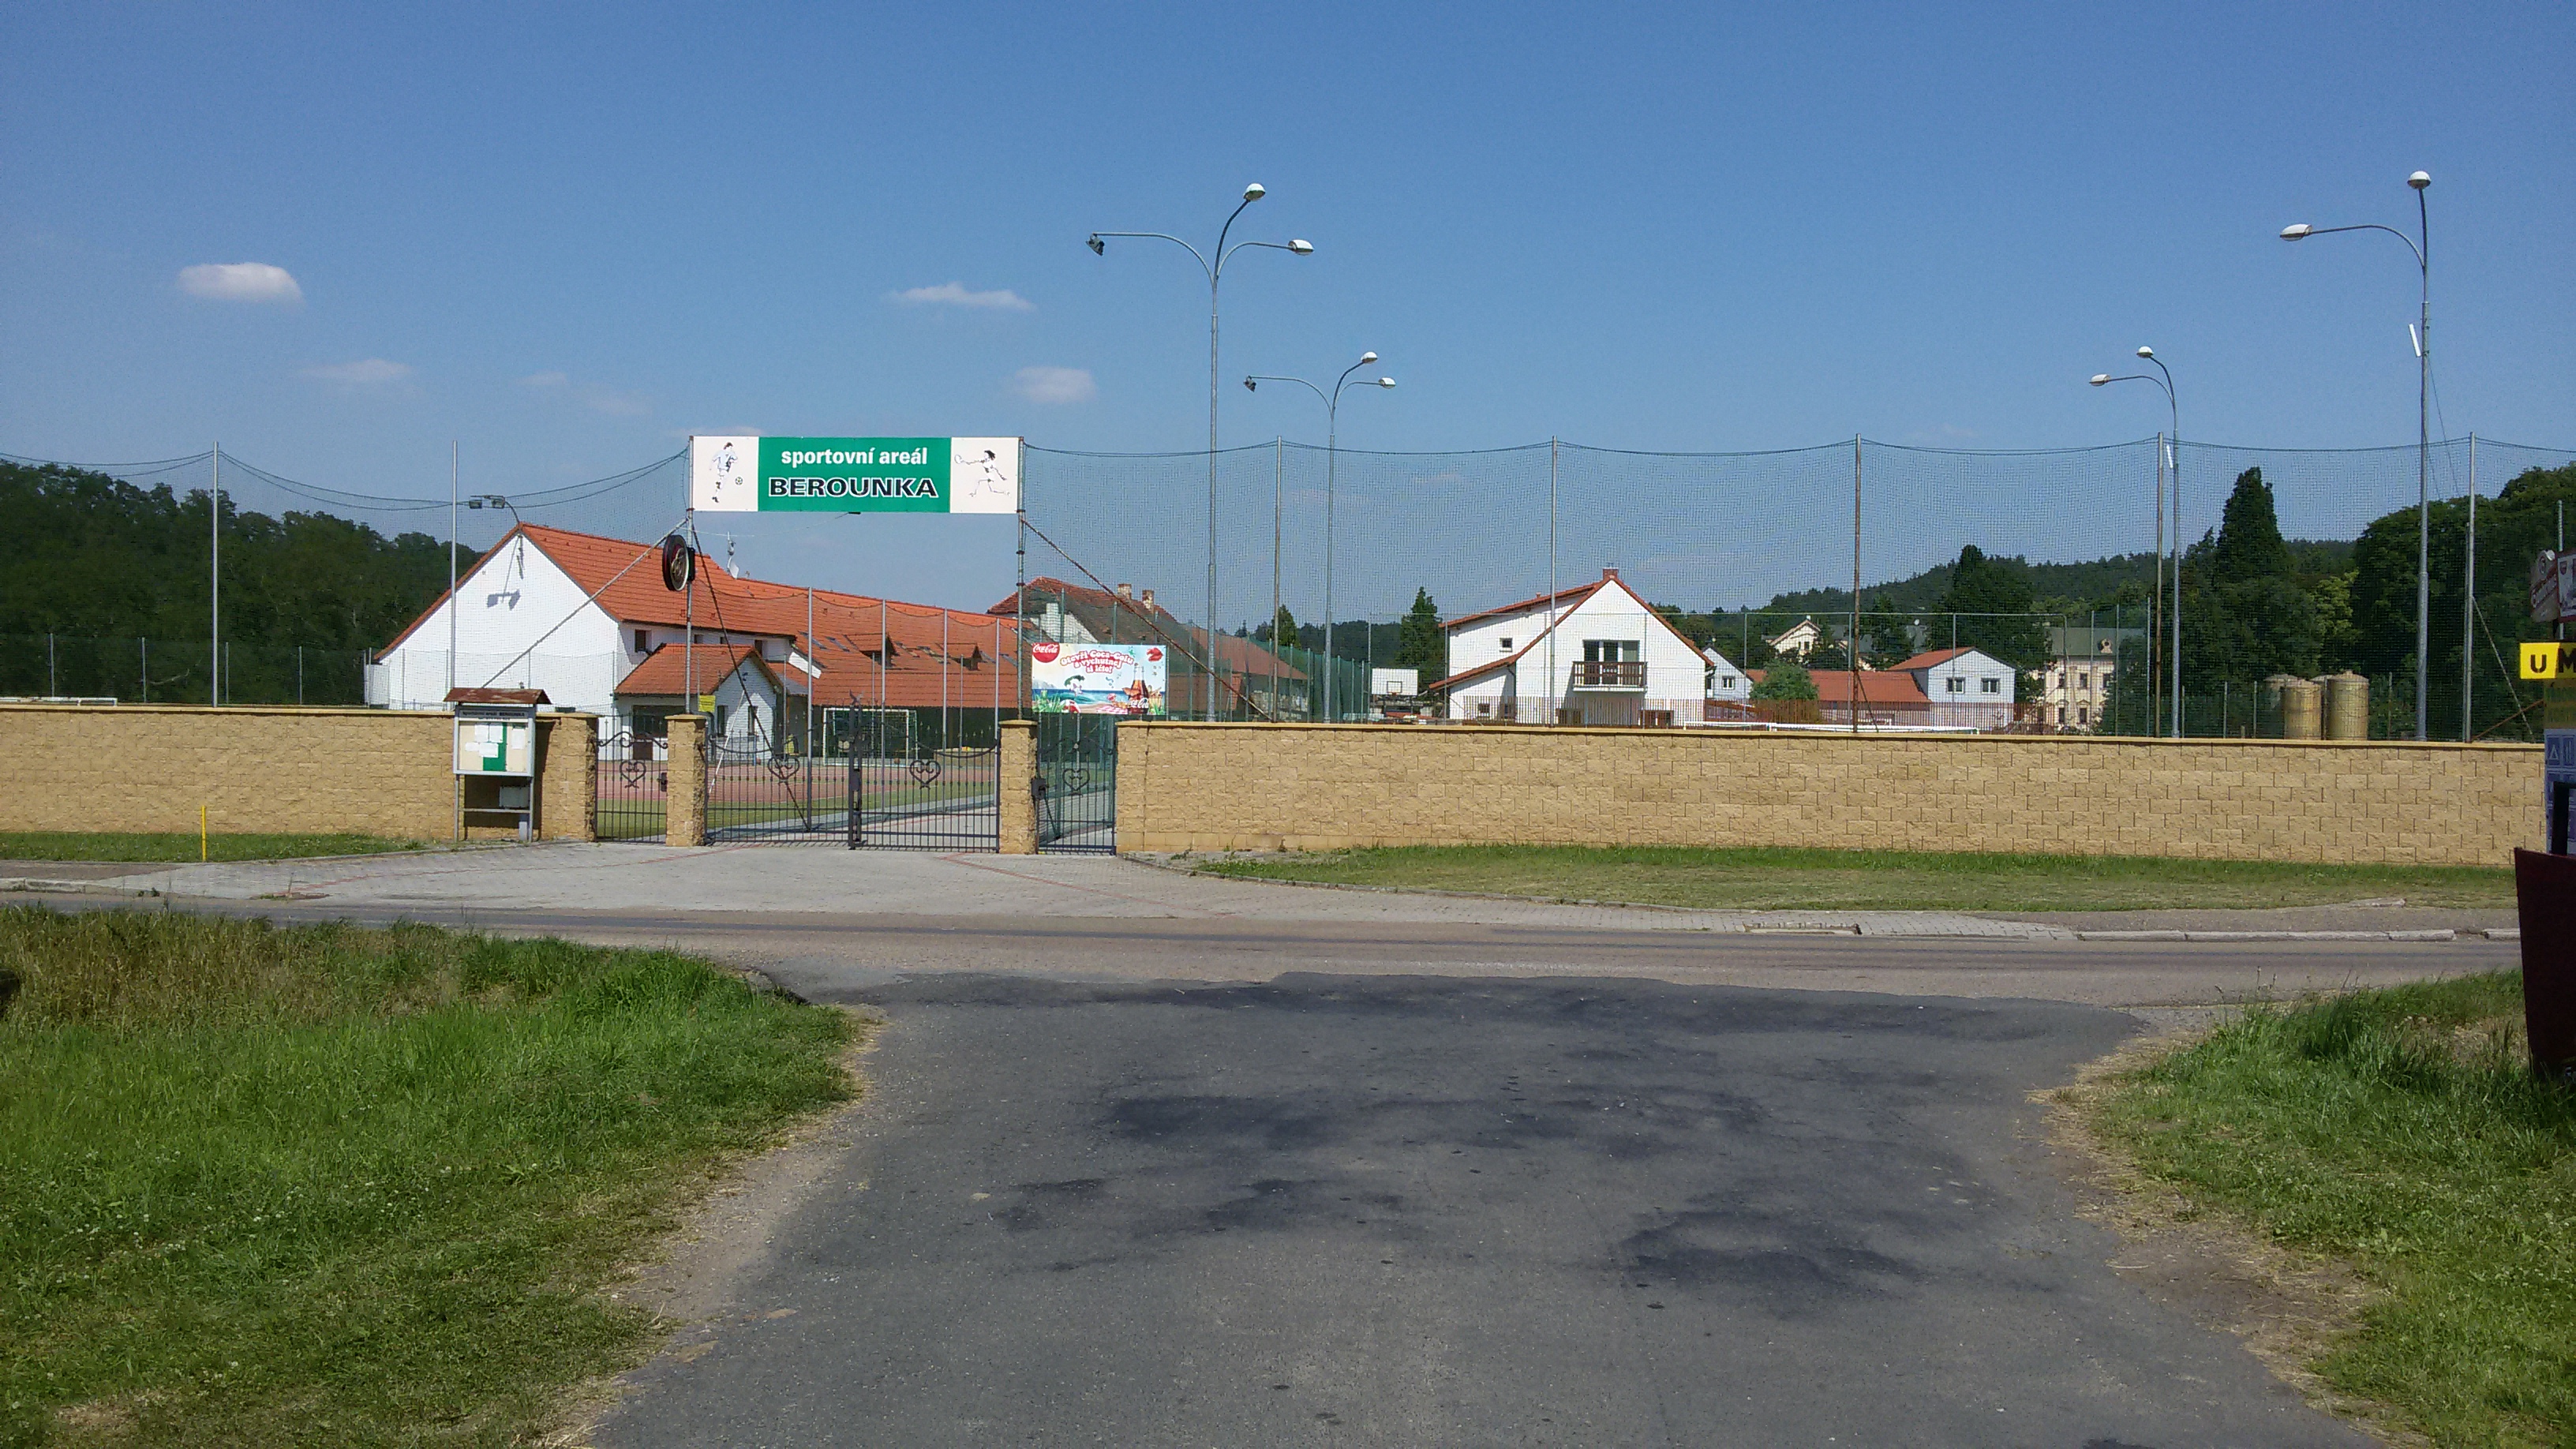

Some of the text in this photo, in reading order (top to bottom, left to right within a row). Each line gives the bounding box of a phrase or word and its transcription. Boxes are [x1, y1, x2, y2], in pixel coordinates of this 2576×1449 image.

[781, 447, 927, 468] sportovní areál
[769, 477, 938, 498] BEROUNKA
[1081, 657, 1121, 668] vychutnej
[1090, 650, 1133, 664] Coca-Colu
[2530, 654, 2547, 673] U
